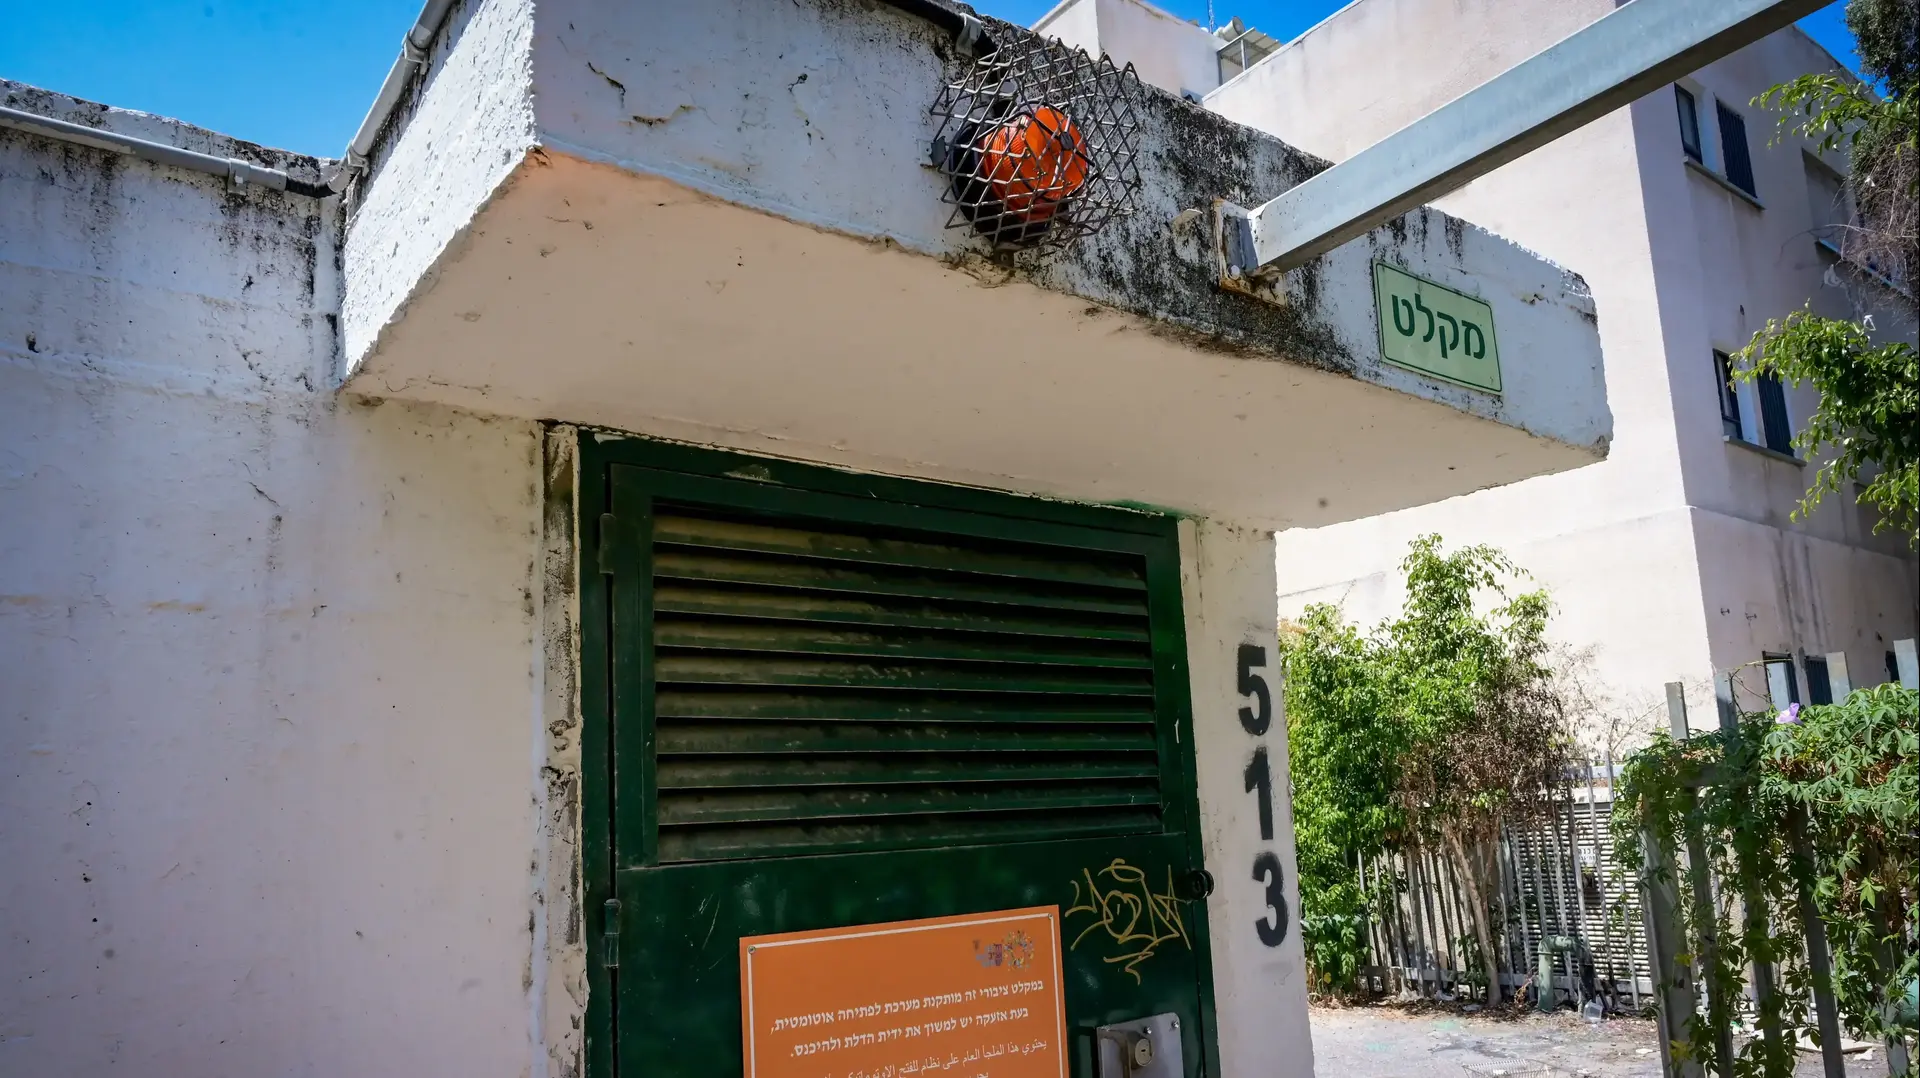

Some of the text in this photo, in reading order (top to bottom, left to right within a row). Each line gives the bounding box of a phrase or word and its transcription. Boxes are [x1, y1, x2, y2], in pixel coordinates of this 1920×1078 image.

[1392, 293, 1486, 360] מקלט
[1238, 643, 1289, 948] 513
[769, 979, 1043, 1035] במקלט ציבורי זה מותקנת מערכת לפתיחה אוטומטית,
[790, 1007, 1028, 1058] בעת אזעקה יש למשוך את ידית הדלת ולהיכנס.
[962, 1047, 980, 1067] العام
[1008, 1041, 1019, 1054] هذا
[1022, 1038, 1047, 1056] يحتوي
[920, 1056, 940, 1075] نظام
[943, 1052, 959, 1070] على
